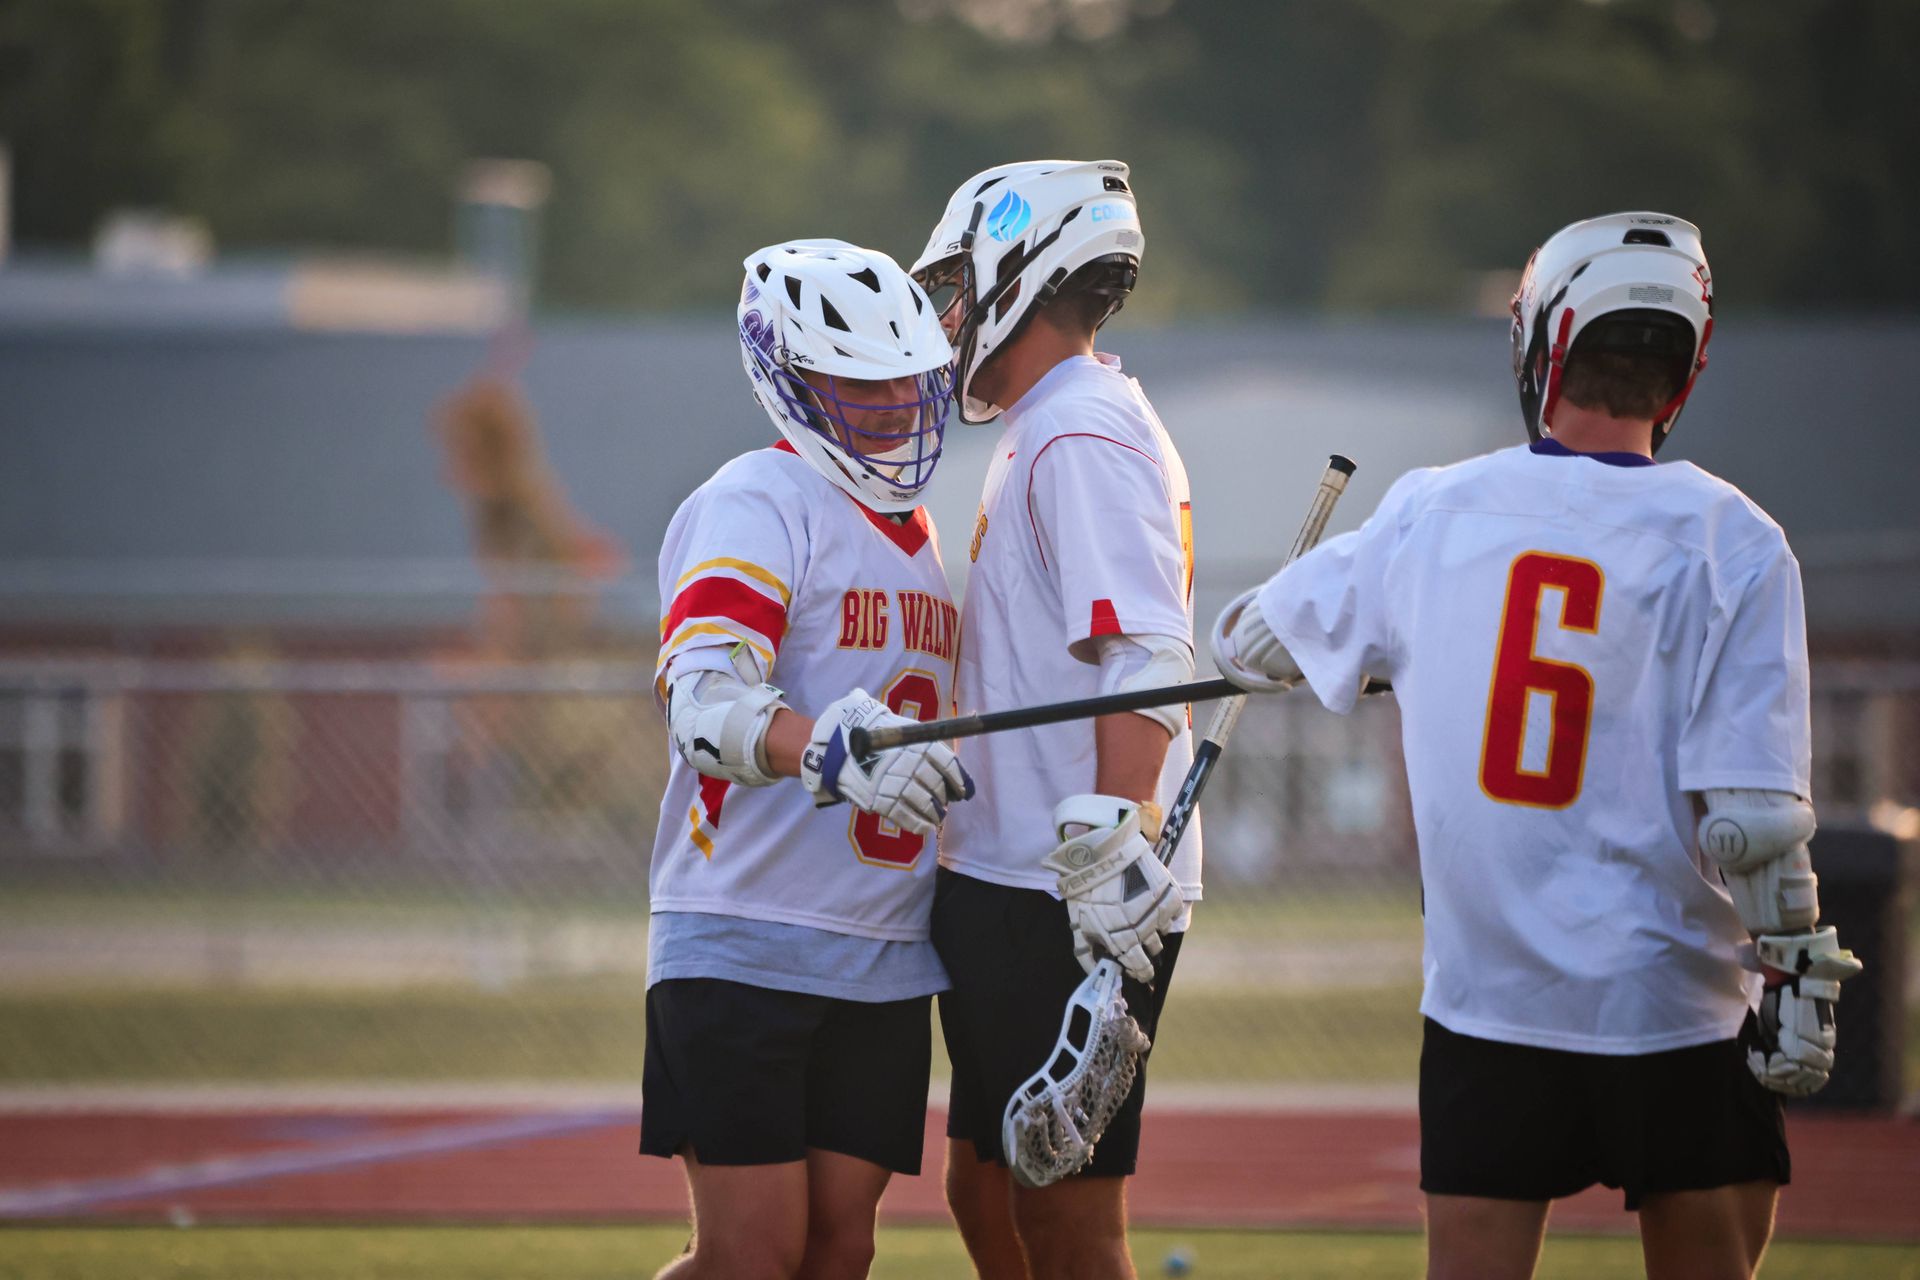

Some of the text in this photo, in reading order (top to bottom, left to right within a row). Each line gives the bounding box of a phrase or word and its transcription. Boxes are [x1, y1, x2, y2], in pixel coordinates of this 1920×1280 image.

[837, 587, 958, 663] BIG WALN
[1478, 549, 1605, 811] 6
